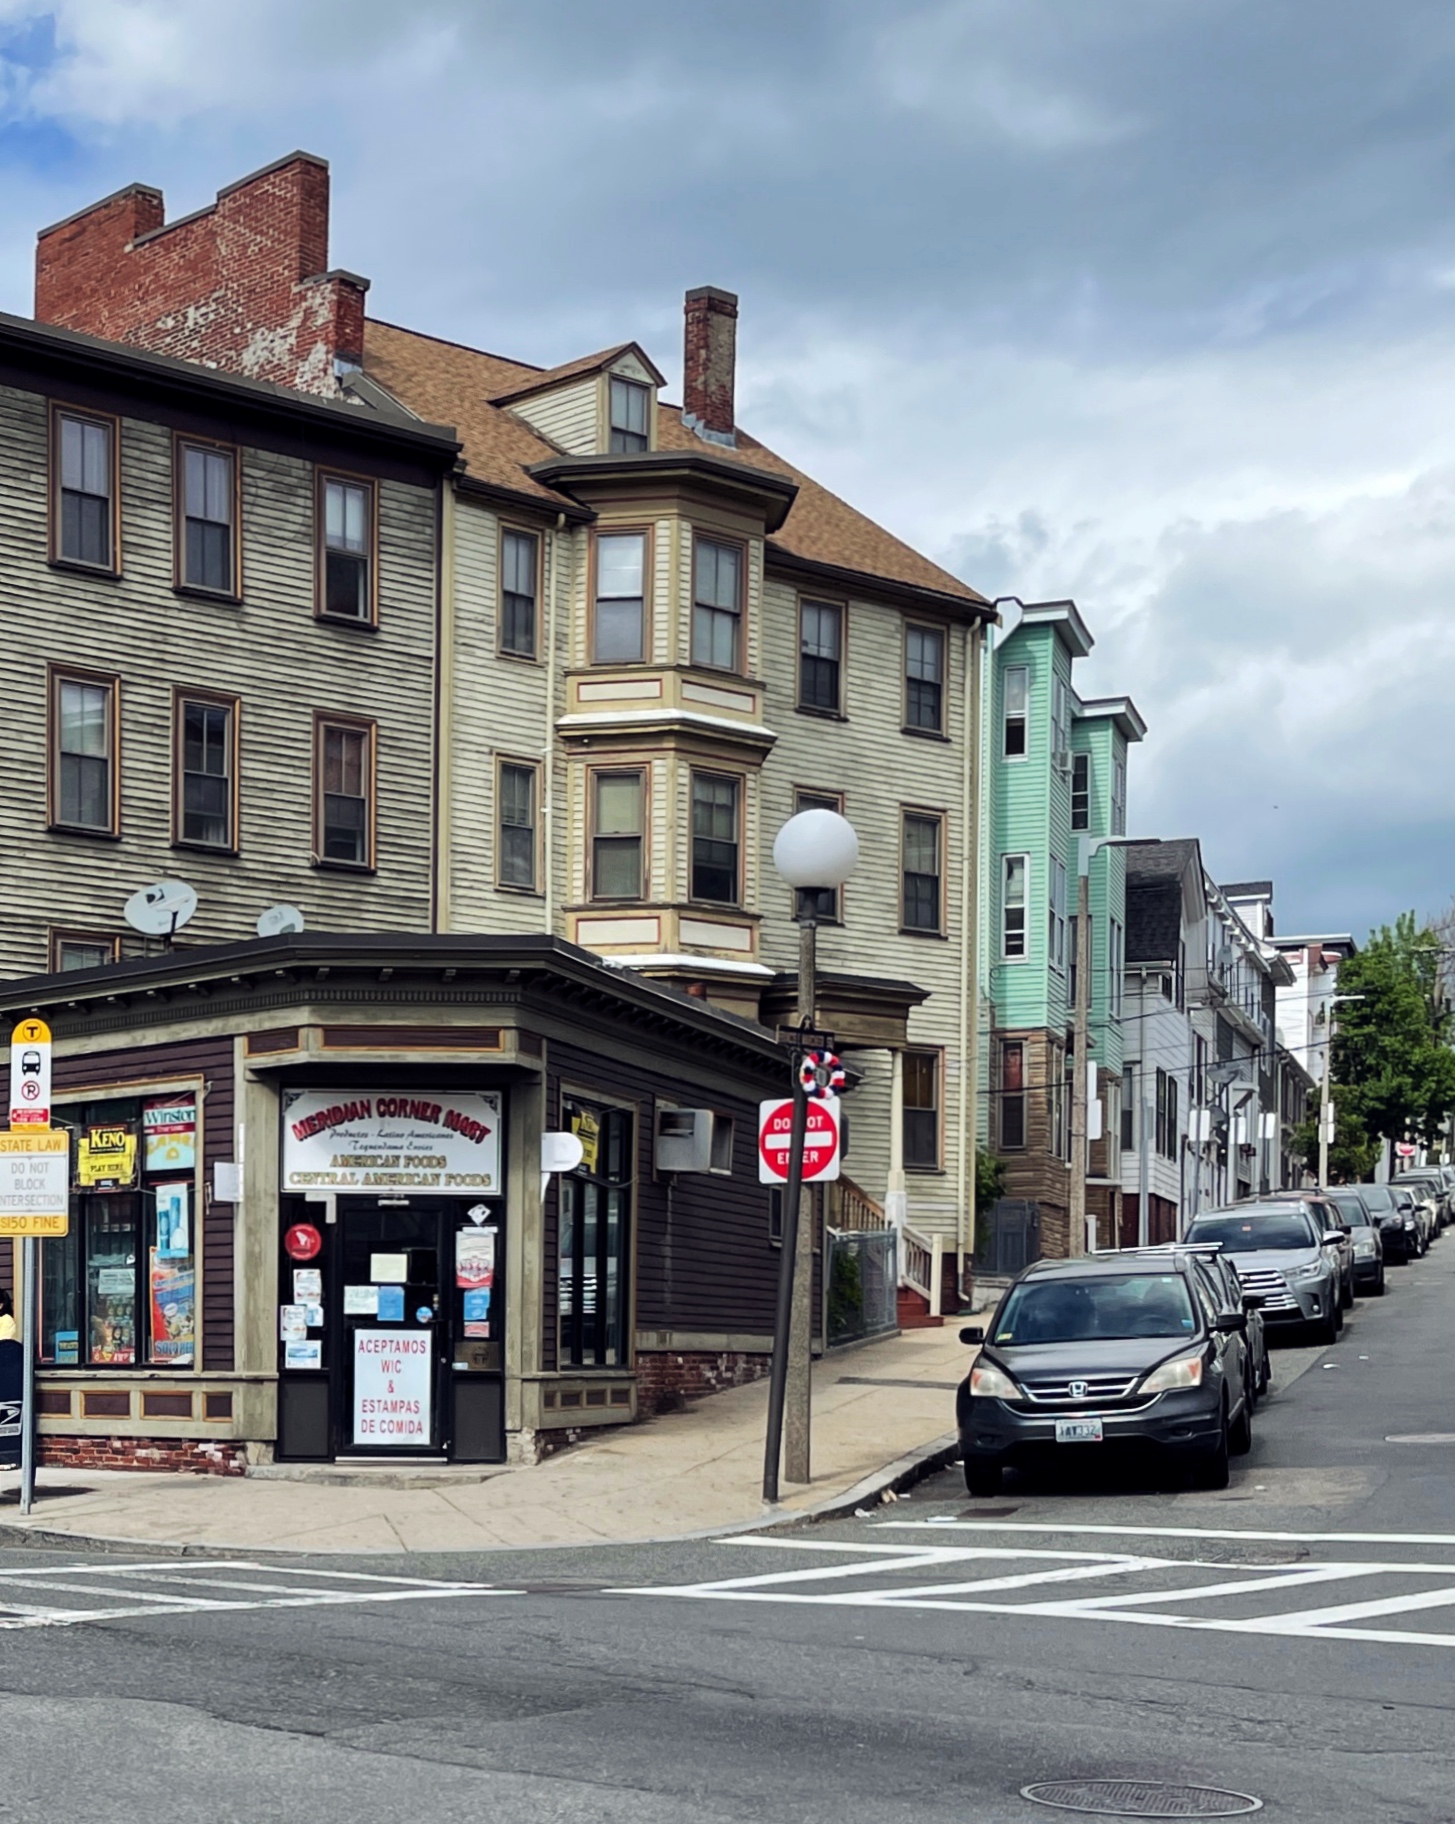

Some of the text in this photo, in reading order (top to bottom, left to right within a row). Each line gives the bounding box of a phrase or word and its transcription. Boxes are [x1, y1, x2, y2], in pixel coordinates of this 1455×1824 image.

[26, 1026, 38, 1038] T
[144, 1110, 196, 1124] Winston
[292, 1098, 492, 1144] MERIDIAN CORNER MART
[774, 1116, 823, 1130] DO OT
[90, 1129, 125, 1148] KENO
[377, 1129, 404, 1138] Latino
[406, 1130, 454, 1140] Americanos
[0, 1139, 62, 1152] STATE LAW
[330, 1154, 447, 1169] AMERICAN FOODS
[777, 1151, 818, 1164] EER
[11, 1162, 50, 1174] DO NOT
[14, 1178, 46, 1190] BLOCK
[289, 1172, 492, 1187] CENTRAL AMERICAN FOODS
[33, 1216, 60, 1228] FINE
[358, 1339, 426, 1354] ACEPTAMOS
[381, 1360, 402, 1374] WIC
[388, 1380, 394, 1393] &
[362, 1400, 420, 1414] ESTAMPAS
[361, 1420, 423, 1434] DE COMIDA
